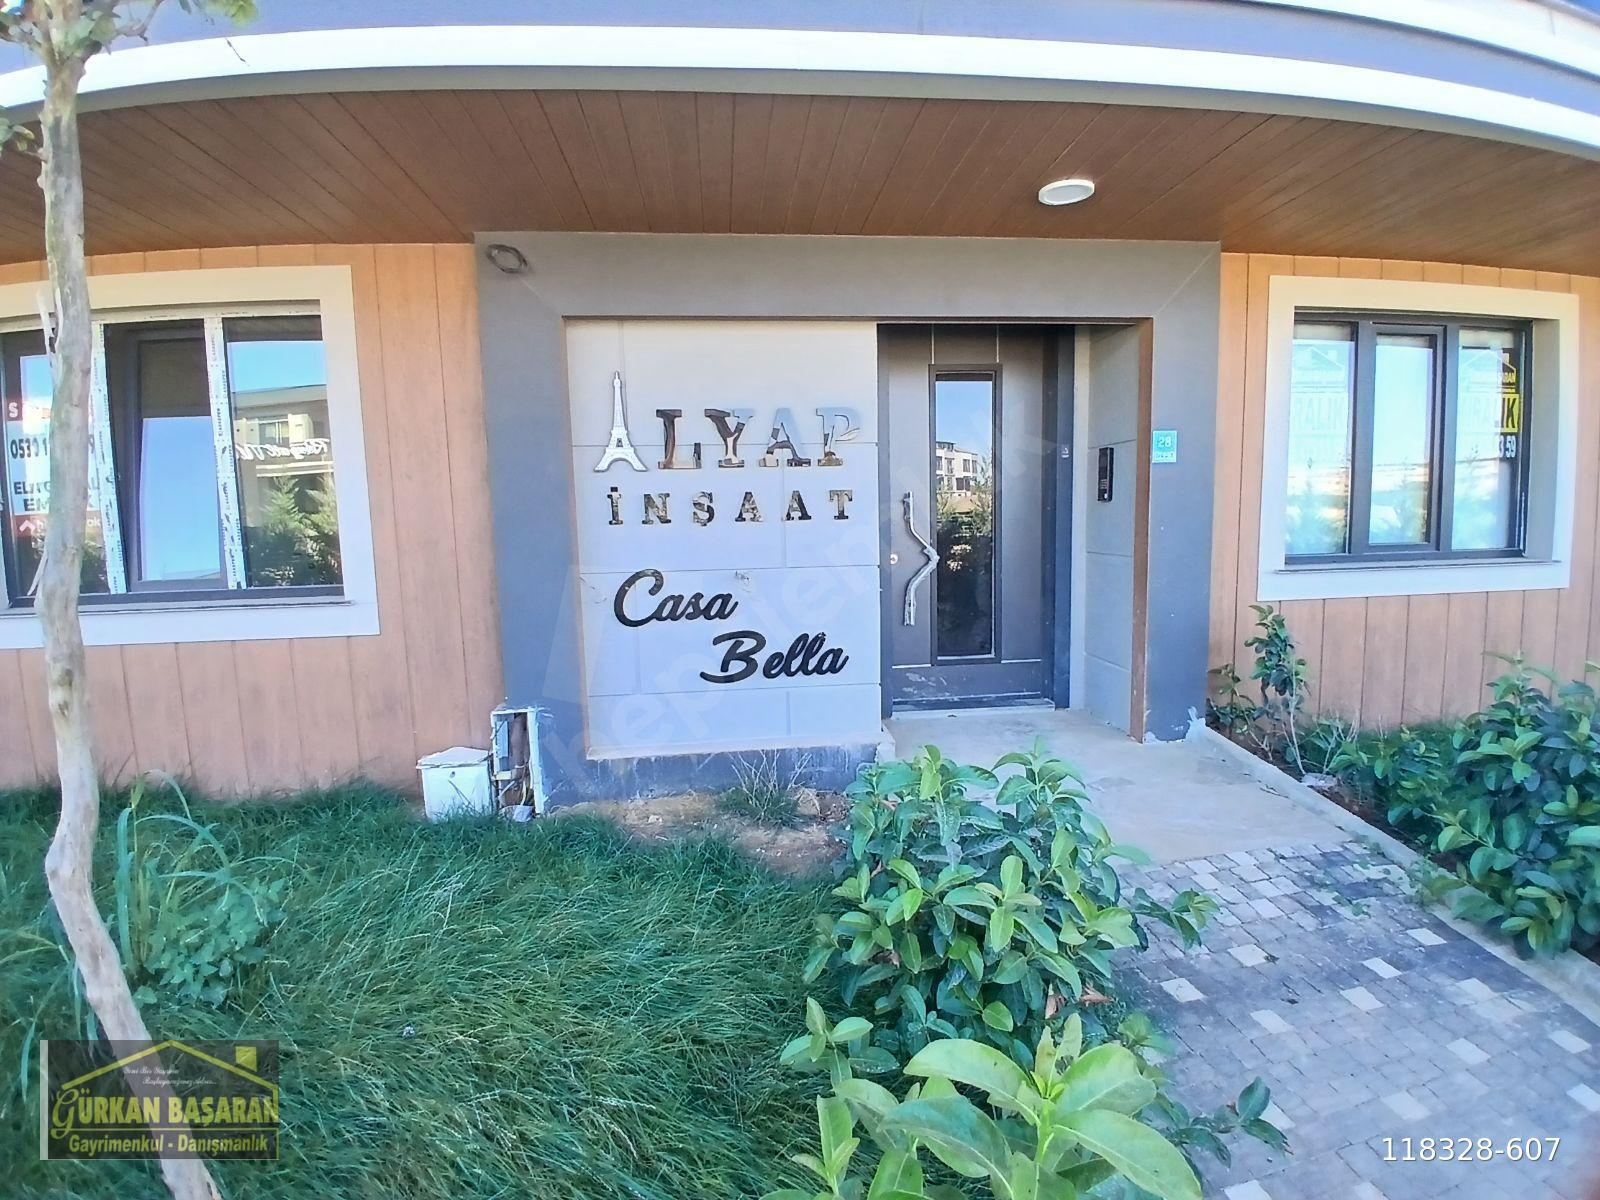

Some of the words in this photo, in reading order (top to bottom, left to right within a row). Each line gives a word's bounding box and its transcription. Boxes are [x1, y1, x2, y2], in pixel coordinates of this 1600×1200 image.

[606, 486, 853, 526] İNŞAAT
[614, 568, 739, 628] Casa
[700, 630, 849, 684] Bella
